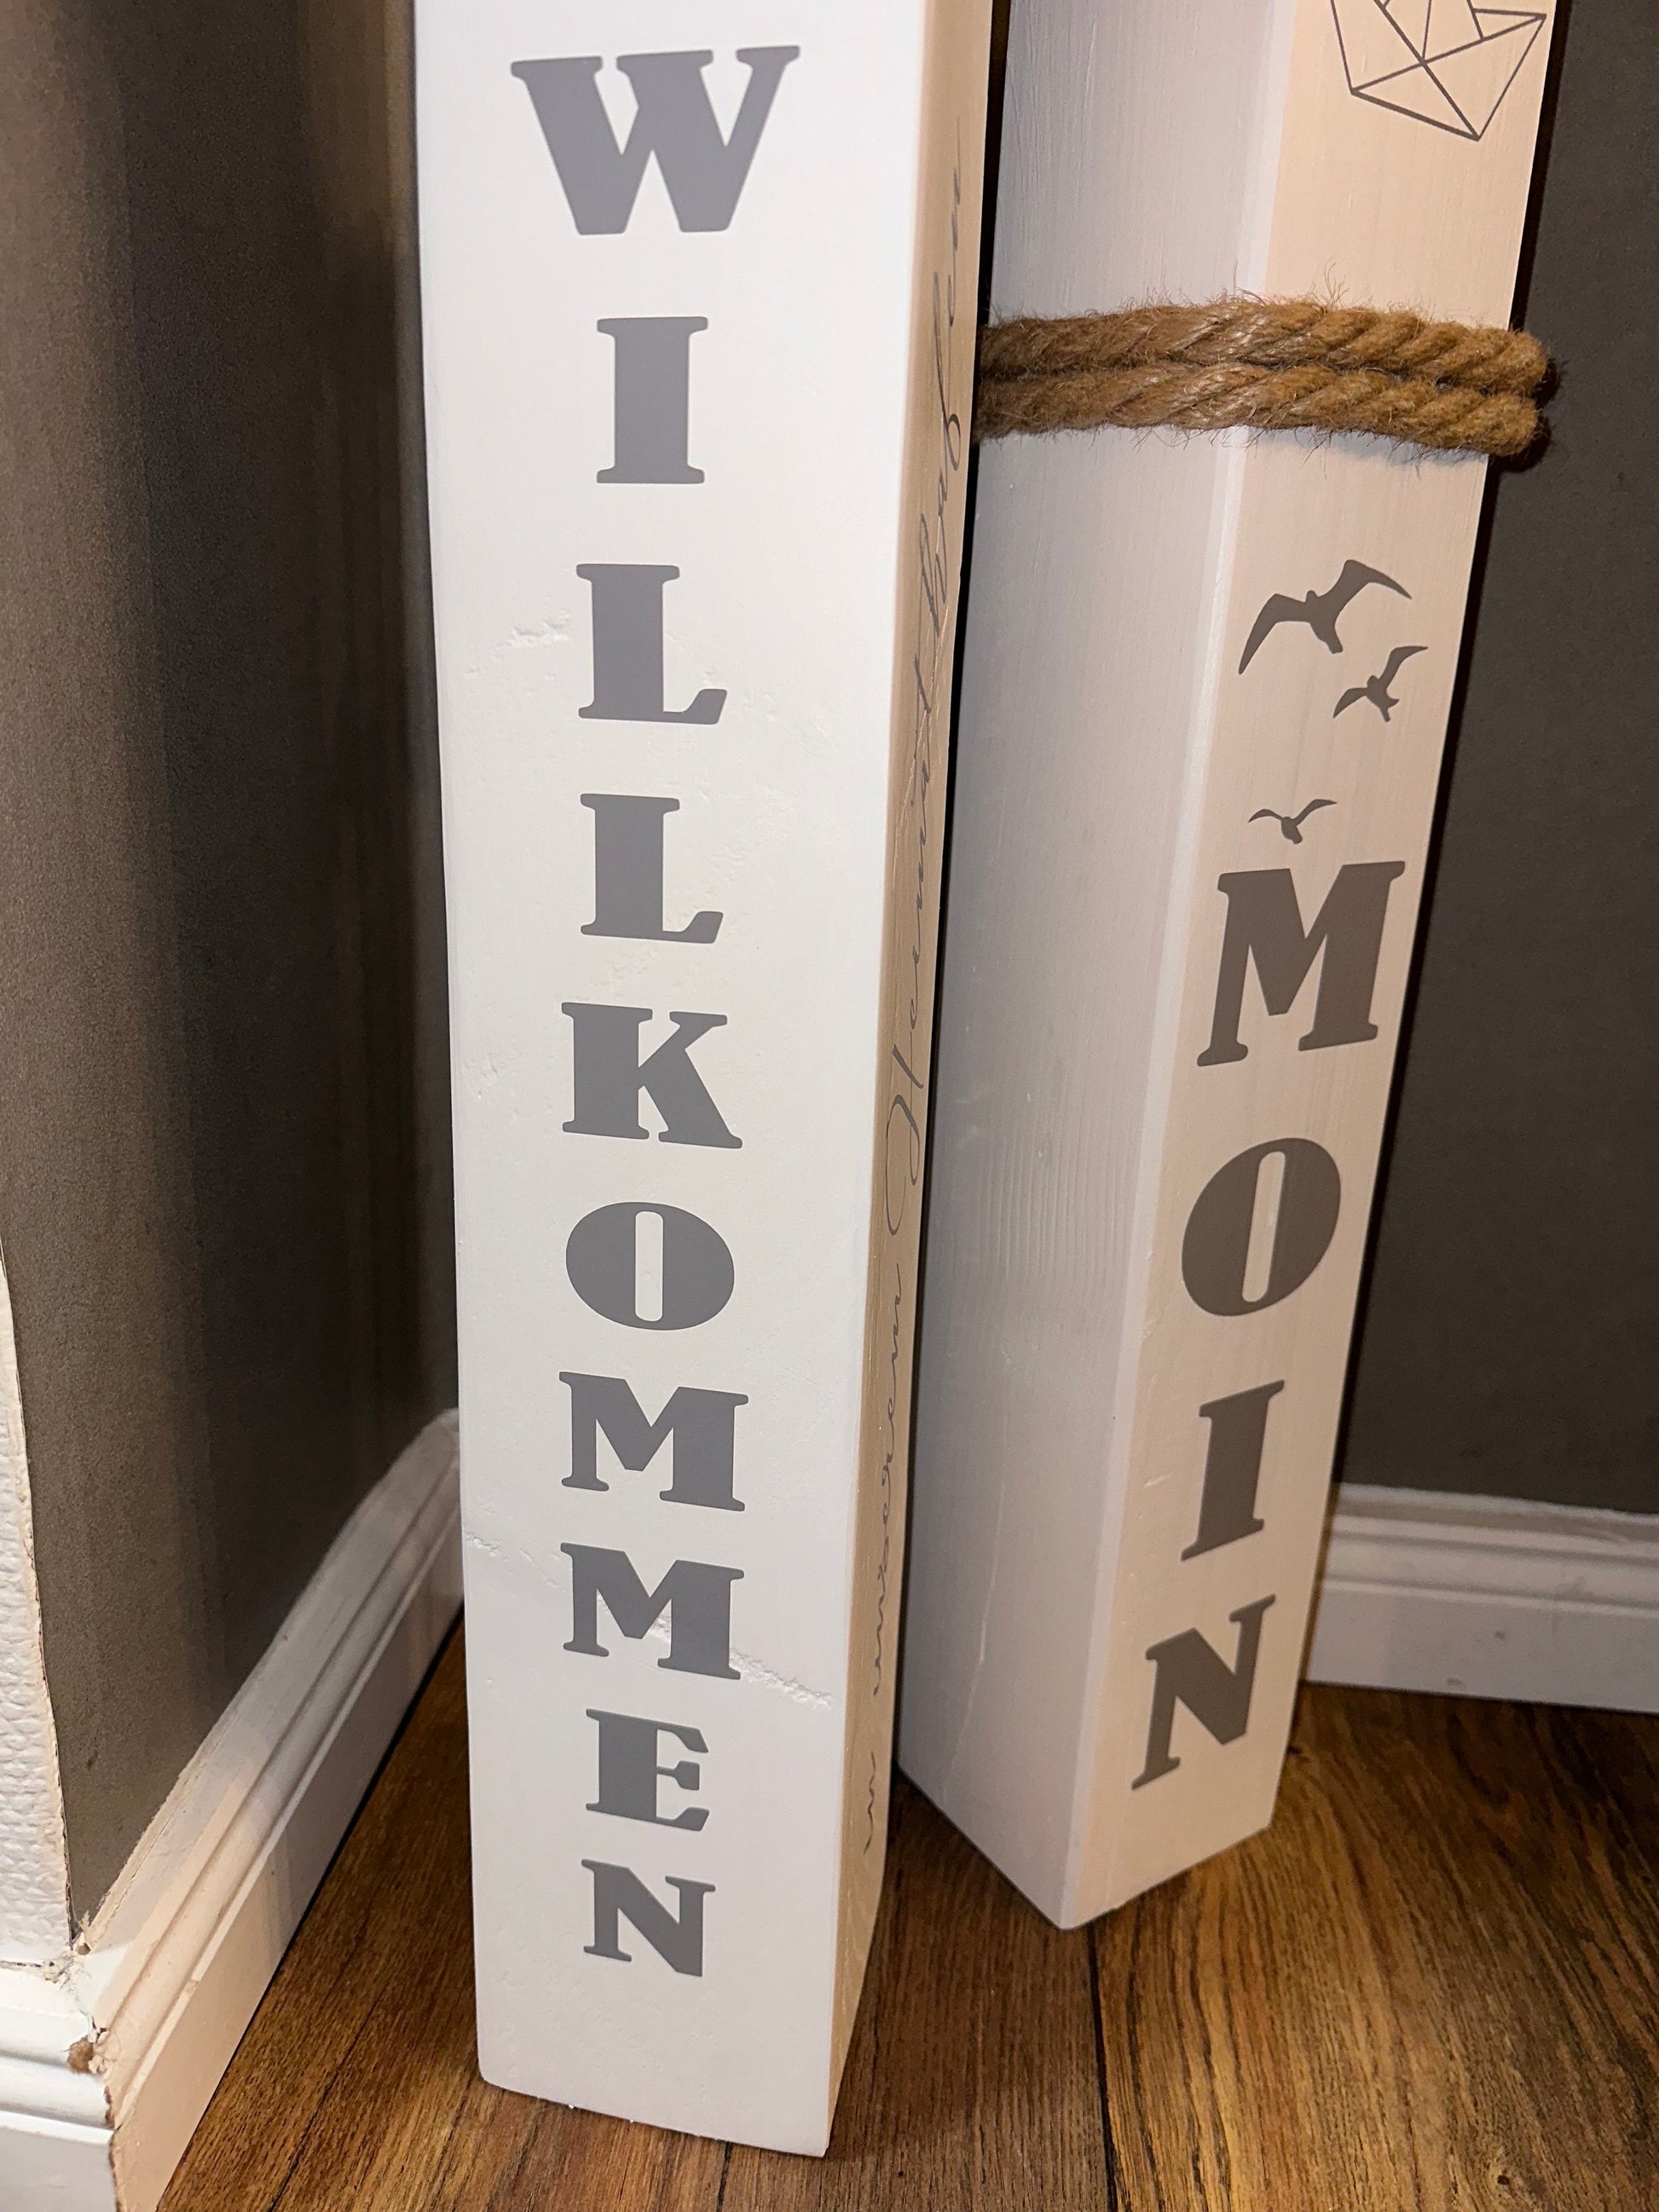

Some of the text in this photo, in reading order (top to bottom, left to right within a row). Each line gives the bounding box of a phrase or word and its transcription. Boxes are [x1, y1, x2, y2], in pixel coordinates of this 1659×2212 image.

[511, 46, 801, 1978] WILLKOMMEN
[1131, 861, 1406, 1791] MOIN
[872, 1262, 903, 1697] unserem
